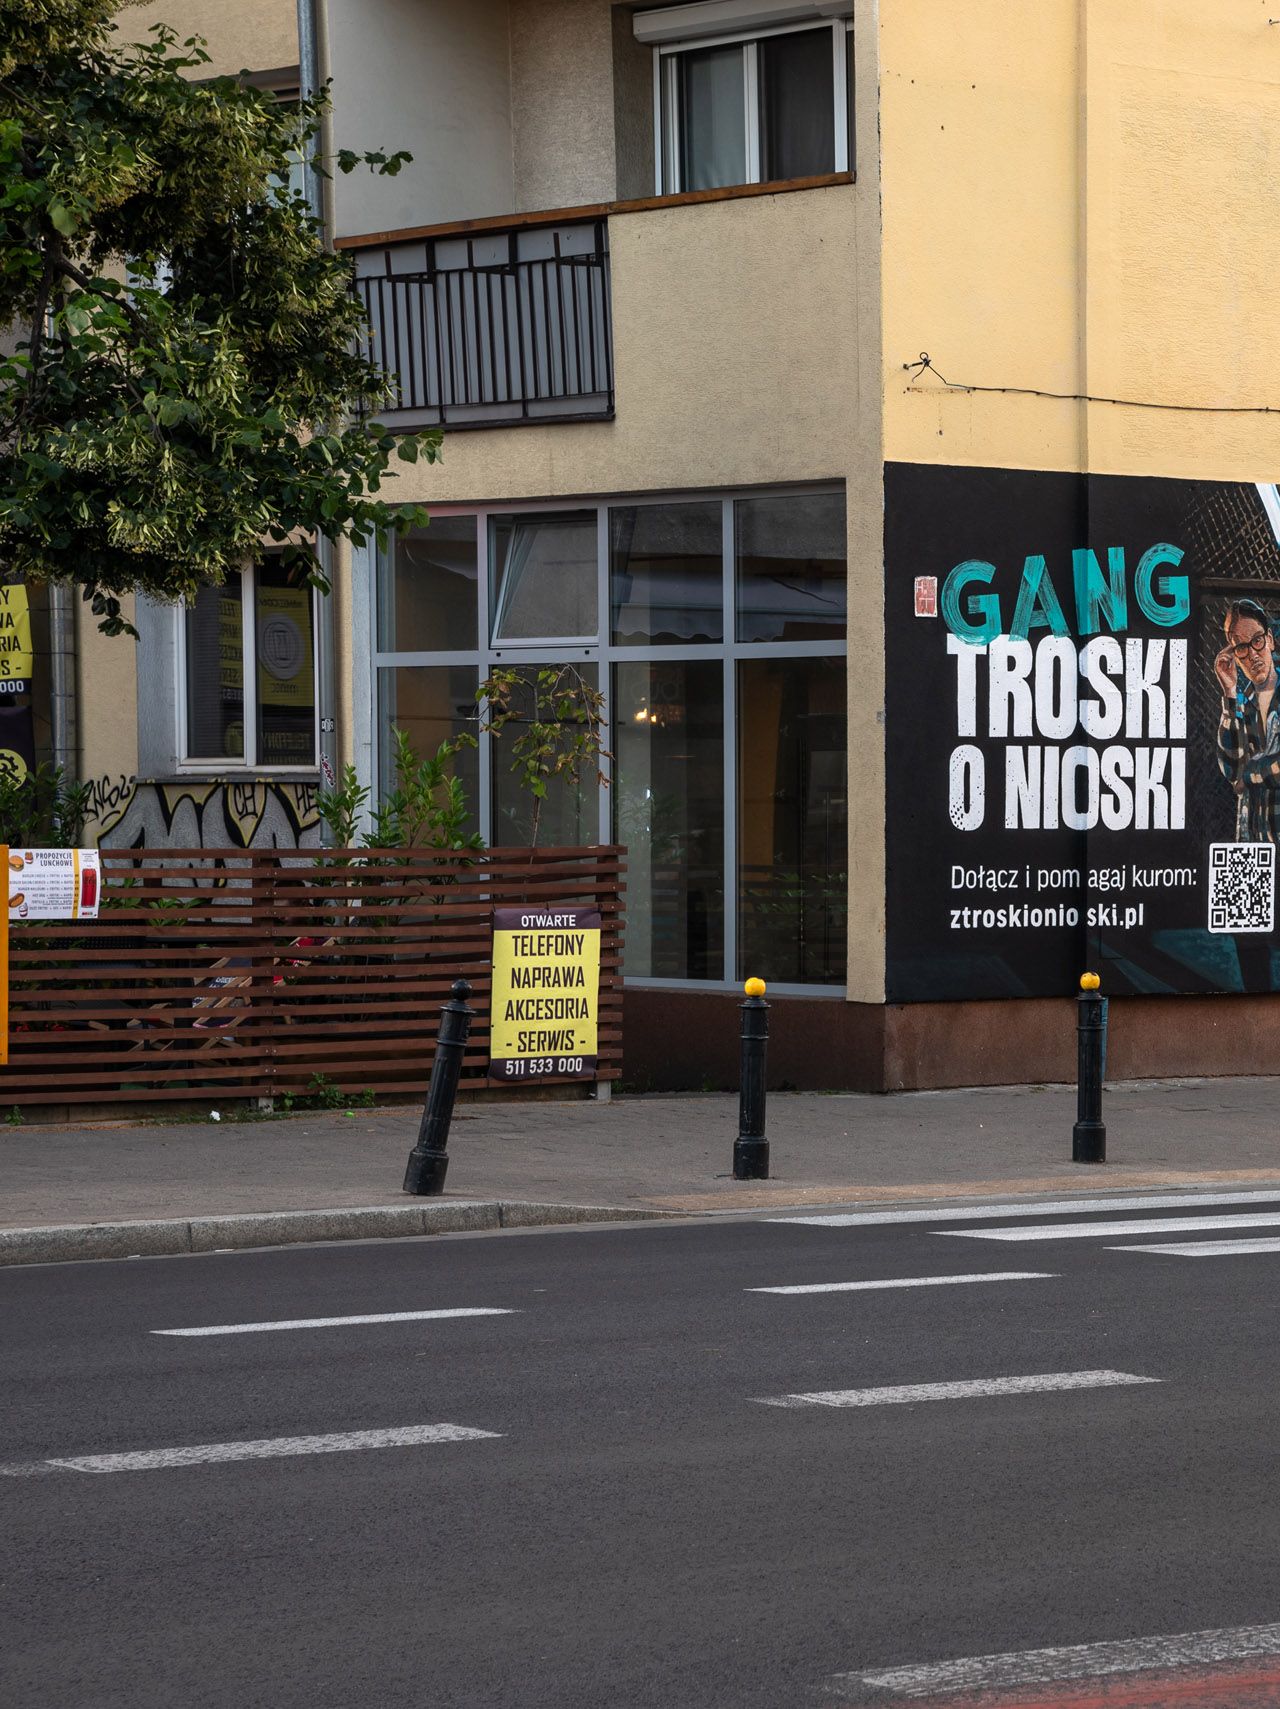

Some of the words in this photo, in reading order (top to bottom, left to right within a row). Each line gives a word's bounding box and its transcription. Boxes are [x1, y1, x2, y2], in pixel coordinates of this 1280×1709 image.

[941, 542, 1190, 646] GANG
[946, 633, 1188, 741] TROSKI
[949, 744, 986, 832] O
[1004, 744, 1187, 832] NIOSKI
[35, 852, 73, 860] PROPOZYCJE
[951, 864, 1019, 892] Dołącz
[1025, 864, 1030, 888] i
[1132, 864, 1198, 888] kurom:
[521, 914, 577, 928] OTWARTE
[511, 934, 585, 957] TELEFONY
[510, 966, 585, 989] NAPRAWA
[504, 997, 589, 1021] AKCESORIA
[517, 1029, 575, 1053] SERWIS
[505, 1059, 525, 1075] 511
[529, 1058, 553, 1074] 533
[558, 1057, 583, 1073] 000
